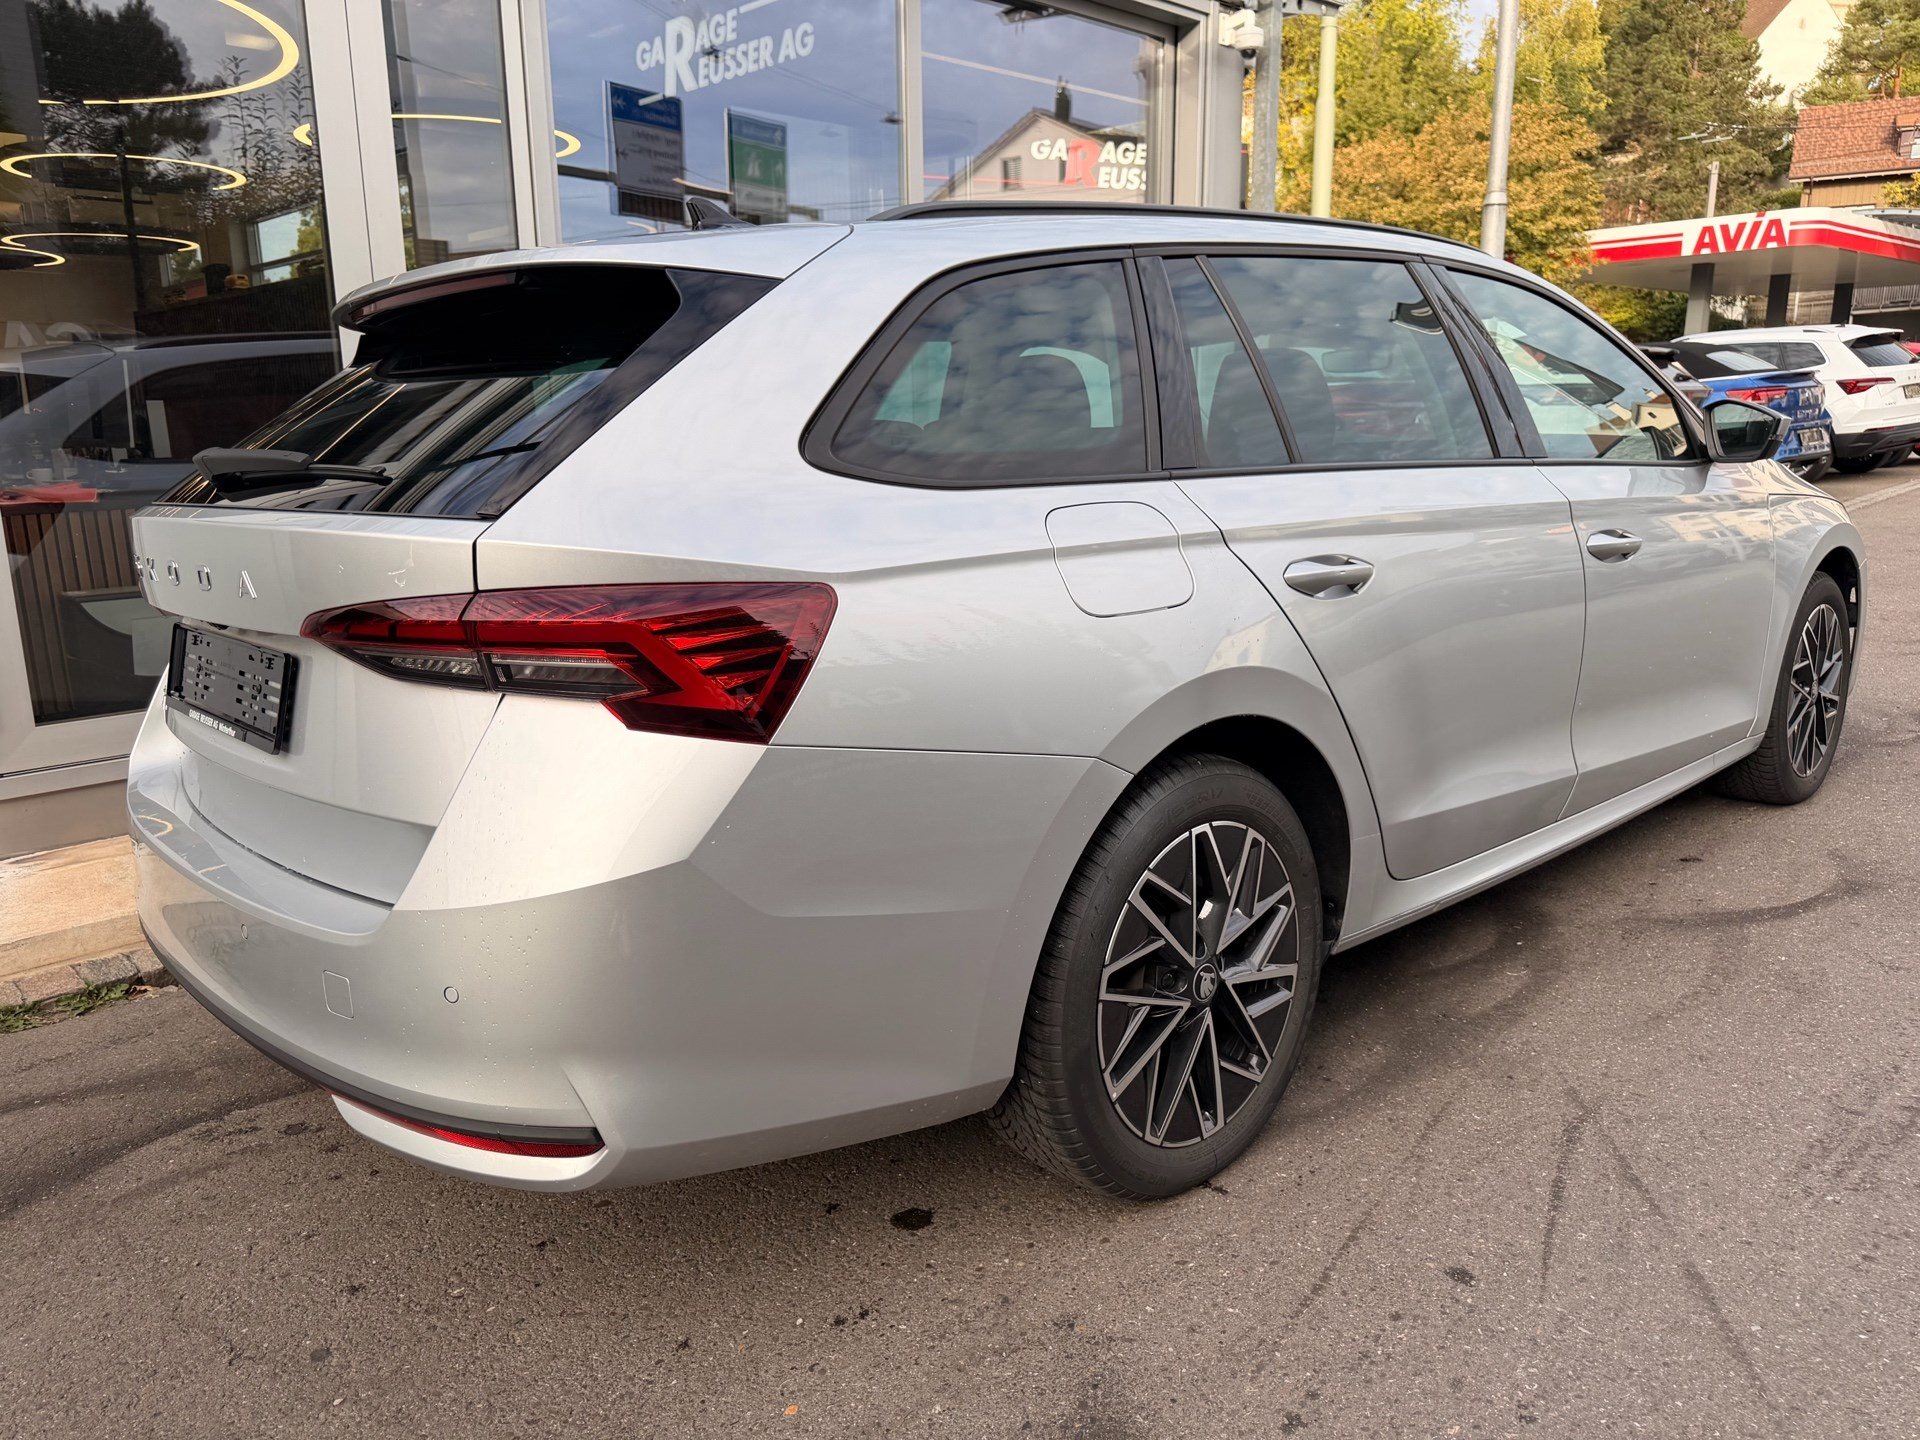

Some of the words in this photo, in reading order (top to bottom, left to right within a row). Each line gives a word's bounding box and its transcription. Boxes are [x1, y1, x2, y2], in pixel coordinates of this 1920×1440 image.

[636, 8, 738, 97] GARAGE
[778, 22, 815, 64] AG
[1030, 138, 1147, 189] GARAGE
